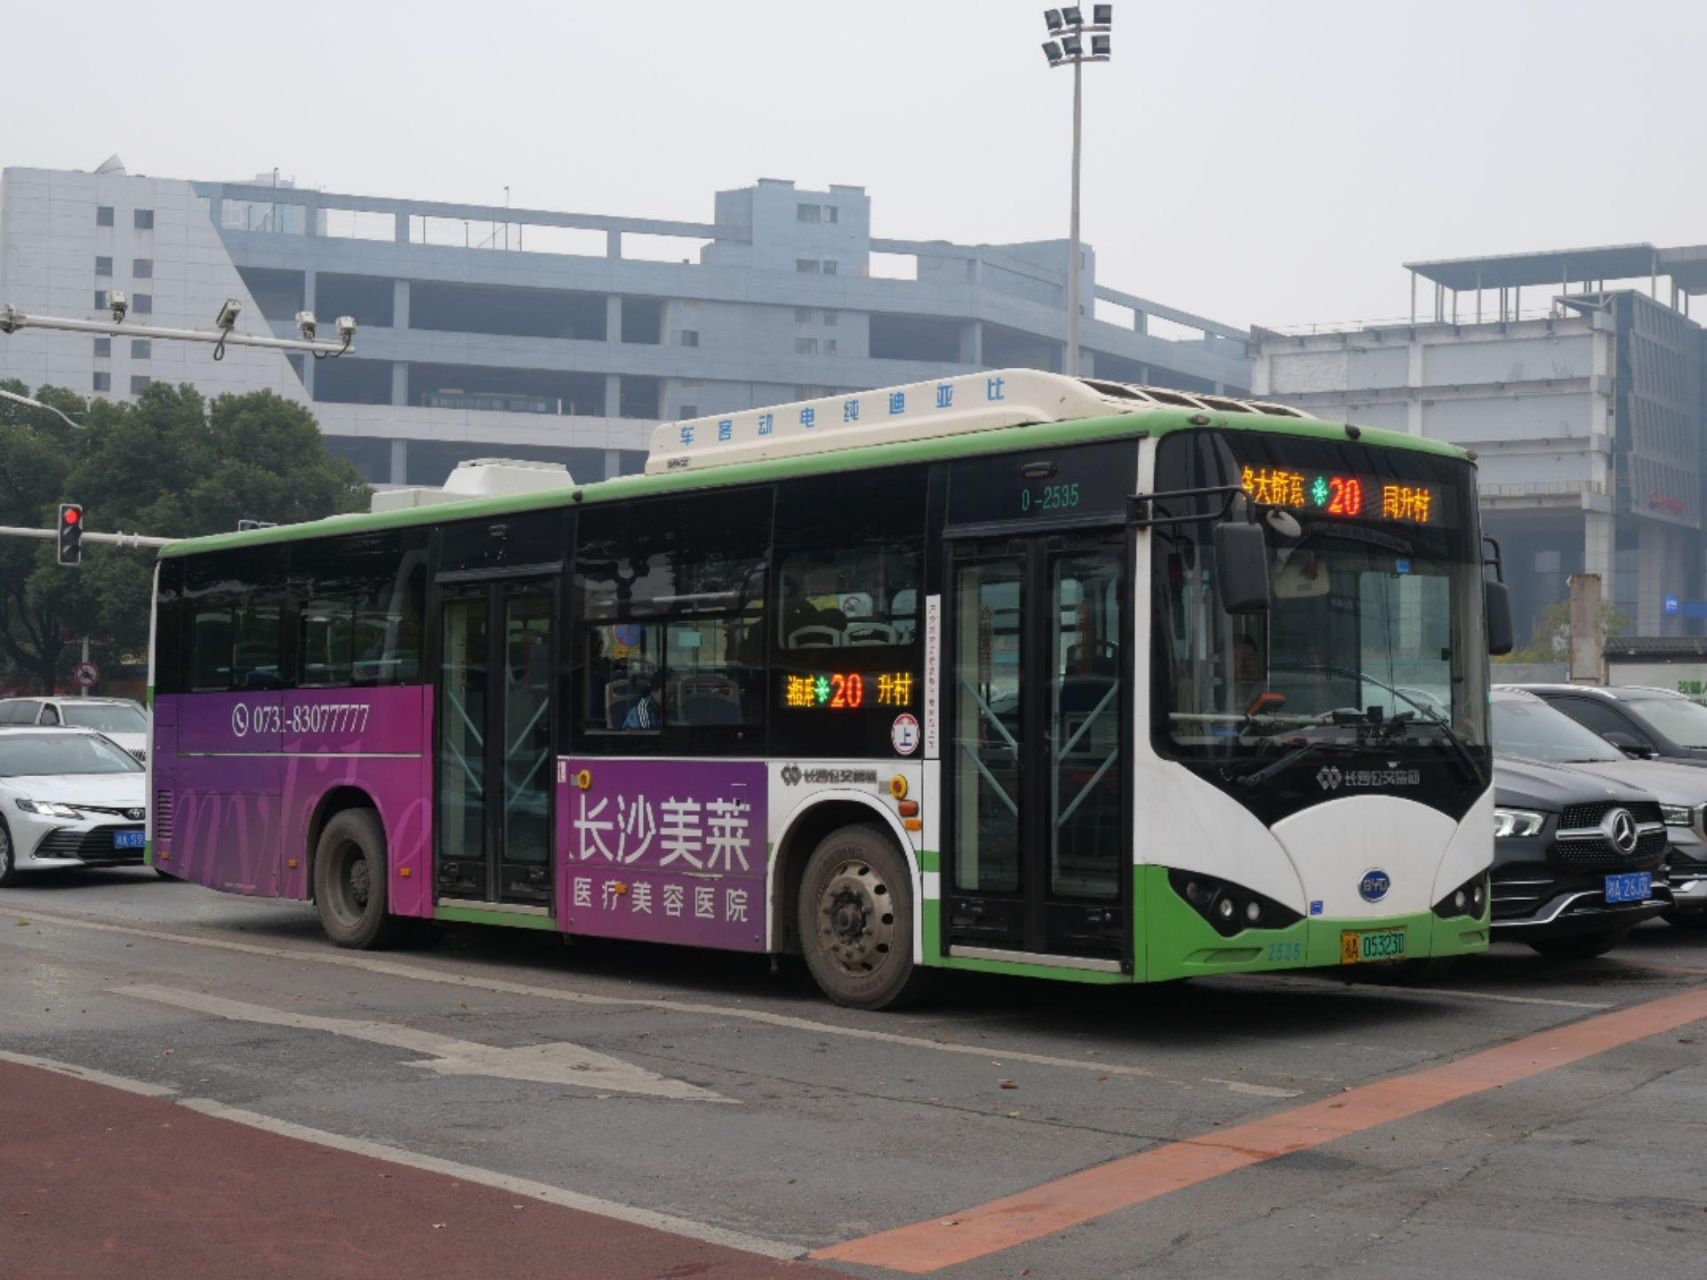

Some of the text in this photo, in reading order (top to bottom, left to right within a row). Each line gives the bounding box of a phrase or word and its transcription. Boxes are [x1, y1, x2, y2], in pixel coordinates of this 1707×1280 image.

[1328, 476, 1362, 515] 20
[830, 673, 863, 708] 20
[254, 704, 370, 733] 0731-83077777
[573, 793, 751, 872] 长沙美莱
[573, 877, 750, 923] 医疗美容医院
[1363, 877, 1388, 893] BYD
[1267, 942, 1301, 962] 2535
